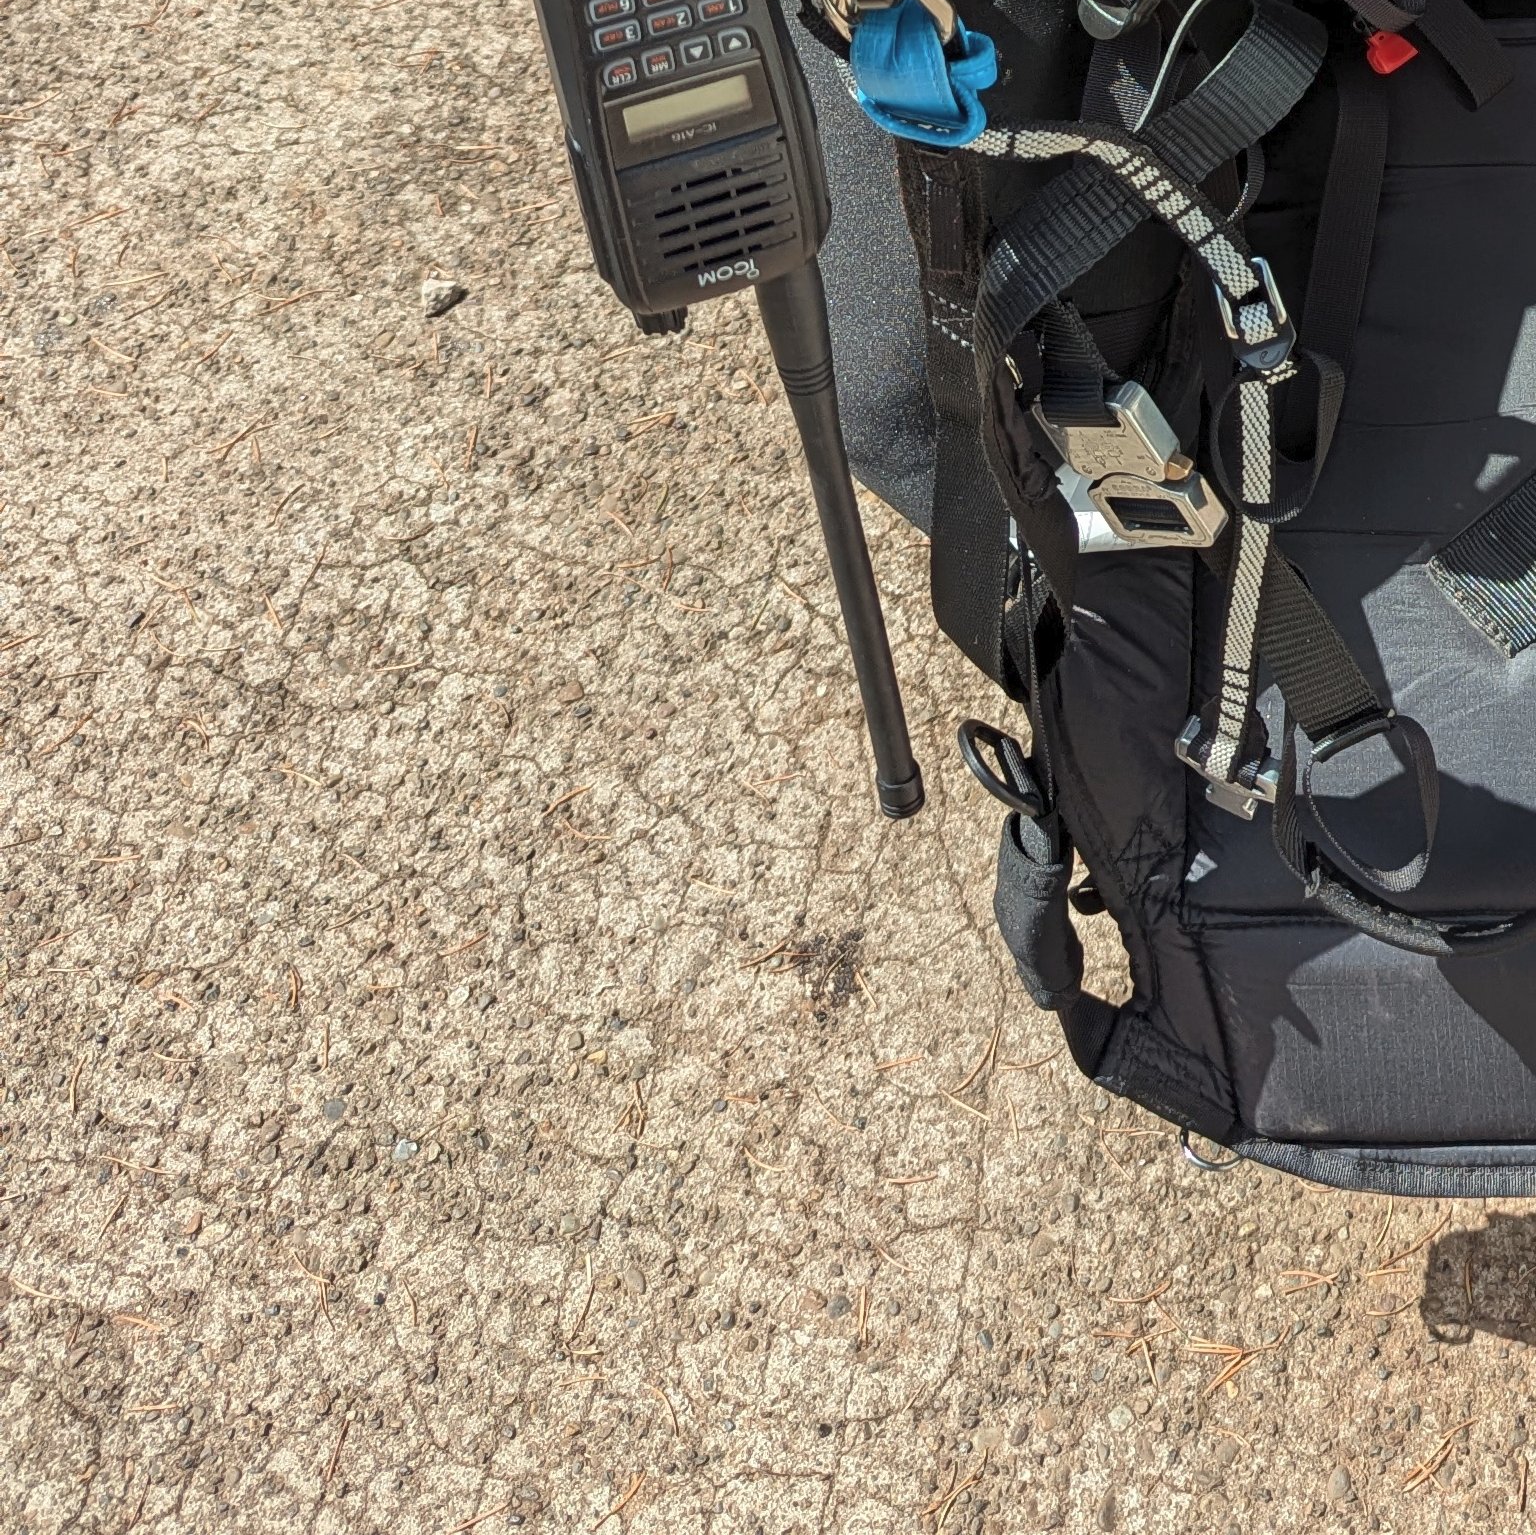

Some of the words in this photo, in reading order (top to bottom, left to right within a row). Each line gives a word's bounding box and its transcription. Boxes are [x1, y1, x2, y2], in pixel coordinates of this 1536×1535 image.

[728, 0, 737, 12] 1
[676, 12, 687, 26] 2
[625, 25, 635, 40] 3
